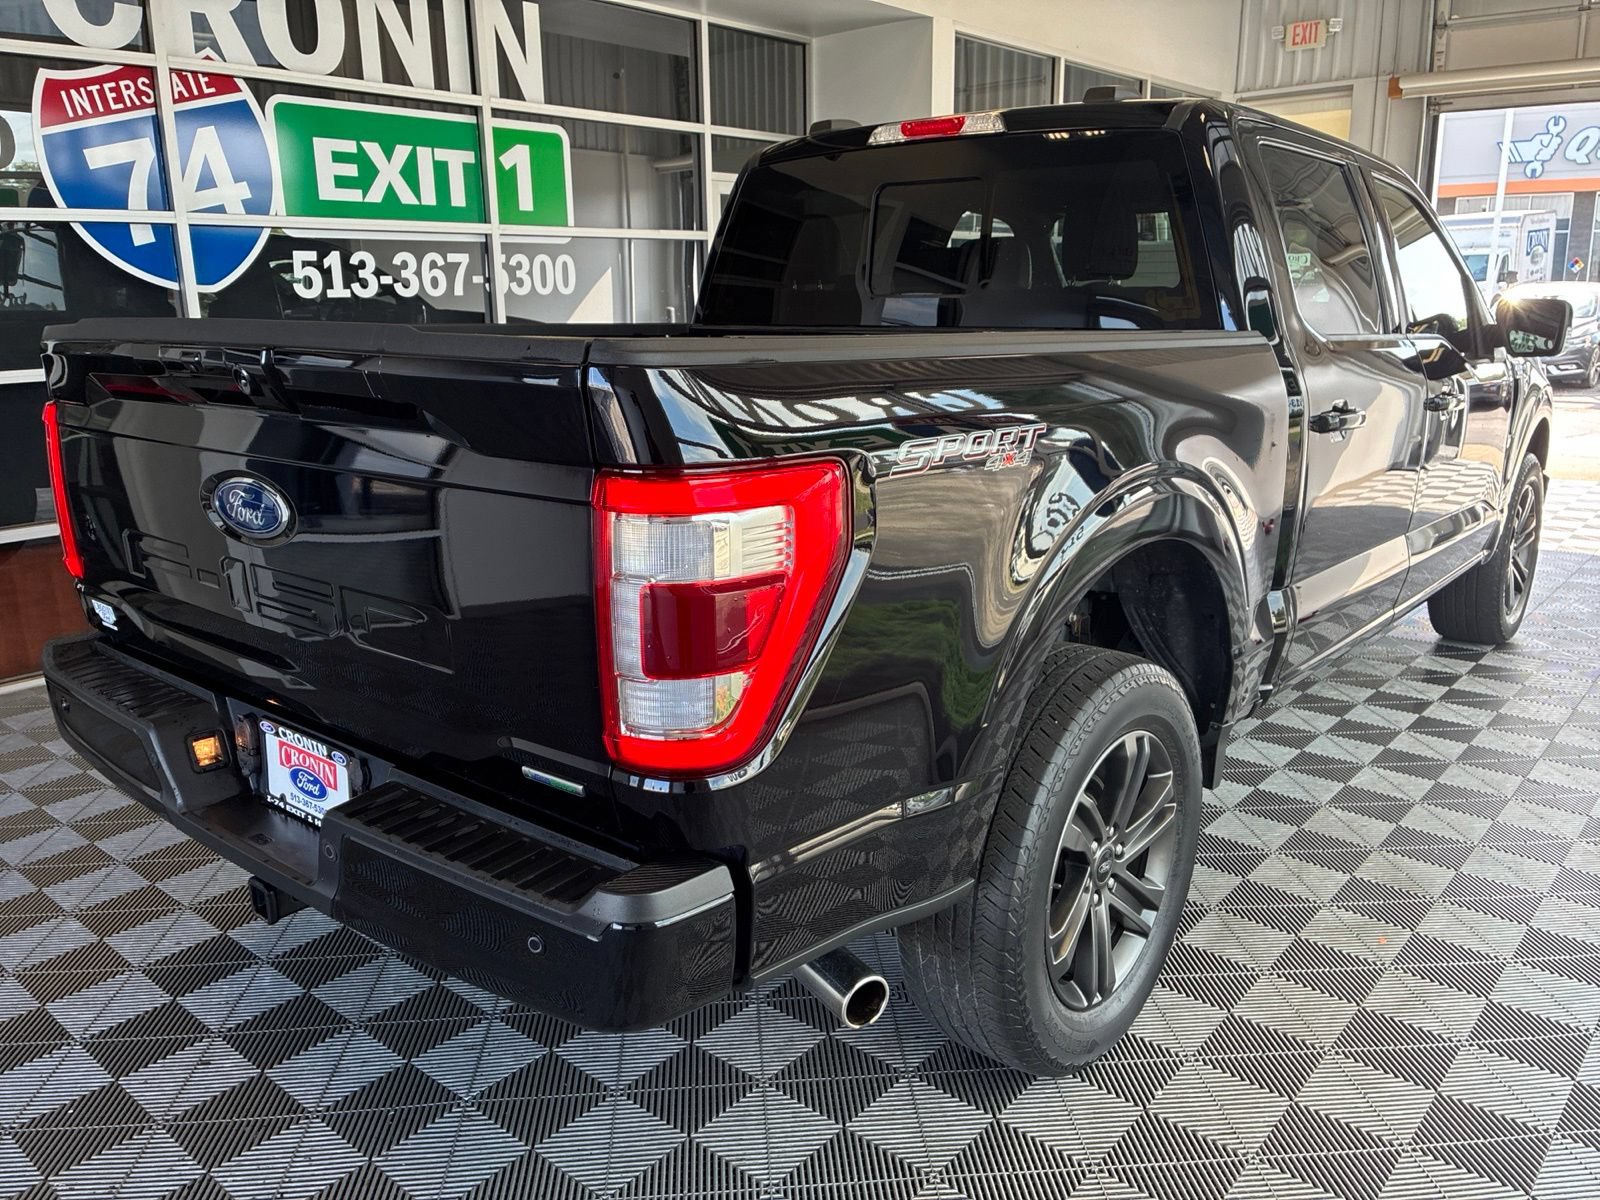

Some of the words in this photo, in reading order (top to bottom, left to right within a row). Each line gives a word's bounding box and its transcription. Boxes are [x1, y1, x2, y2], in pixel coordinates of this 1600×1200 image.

[1291, 21, 1321, 46] EXIT
[60, 71, 217, 118] INTERSATE
[1564, 125, 1600, 165] Q
[83, 125, 252, 247] 74
[312, 136, 476, 208] EXIT
[498, 143, 534, 212] 1
[889, 422, 1048, 479] SPORT
[226, 489, 265, 526] Ford
[278, 726, 328, 757] CRONIN
[281, 745, 336, 789] CRONIN
[296, 771, 321, 796] Ford
[286, 804, 307, 819] EXIT
